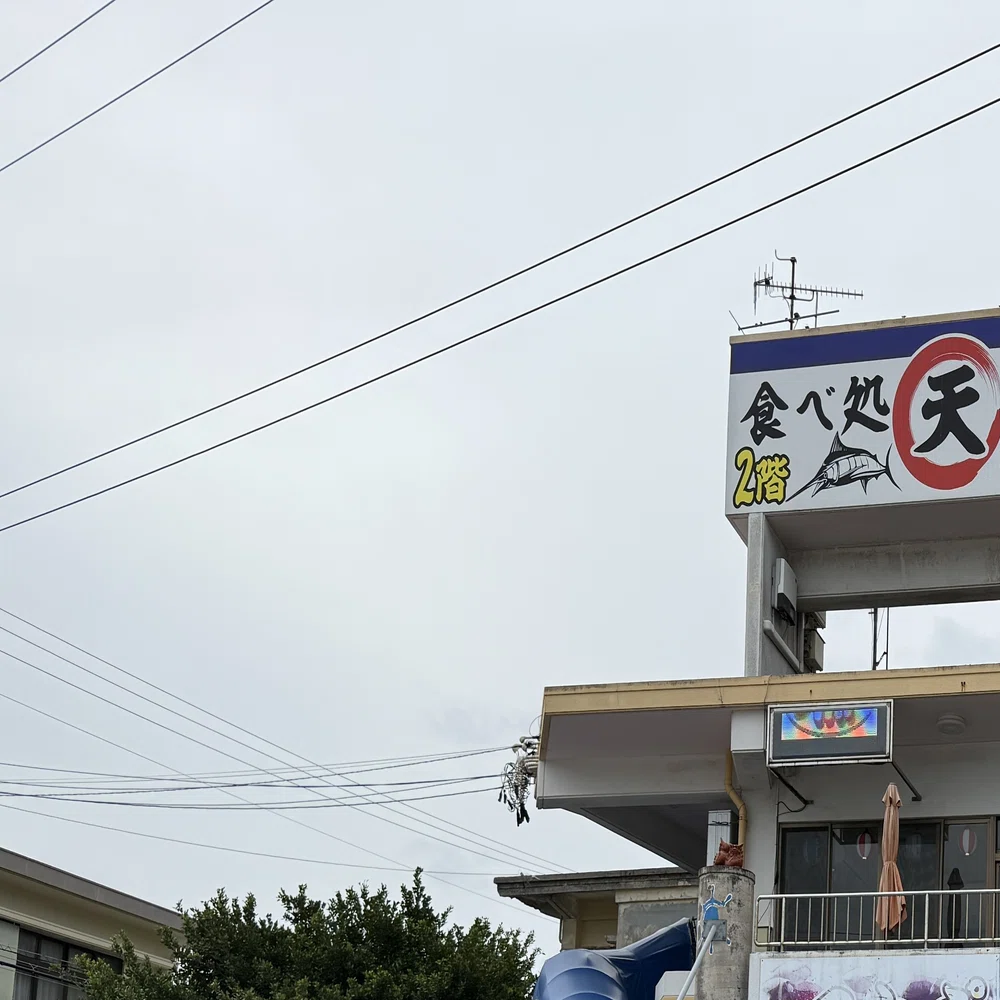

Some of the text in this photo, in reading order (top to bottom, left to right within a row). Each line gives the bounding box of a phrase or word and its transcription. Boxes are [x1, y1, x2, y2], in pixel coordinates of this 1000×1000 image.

[740, 374, 891, 446] 食べ処
[913, 363, 987, 456] 天
[733, 446, 791, 509] 2階
